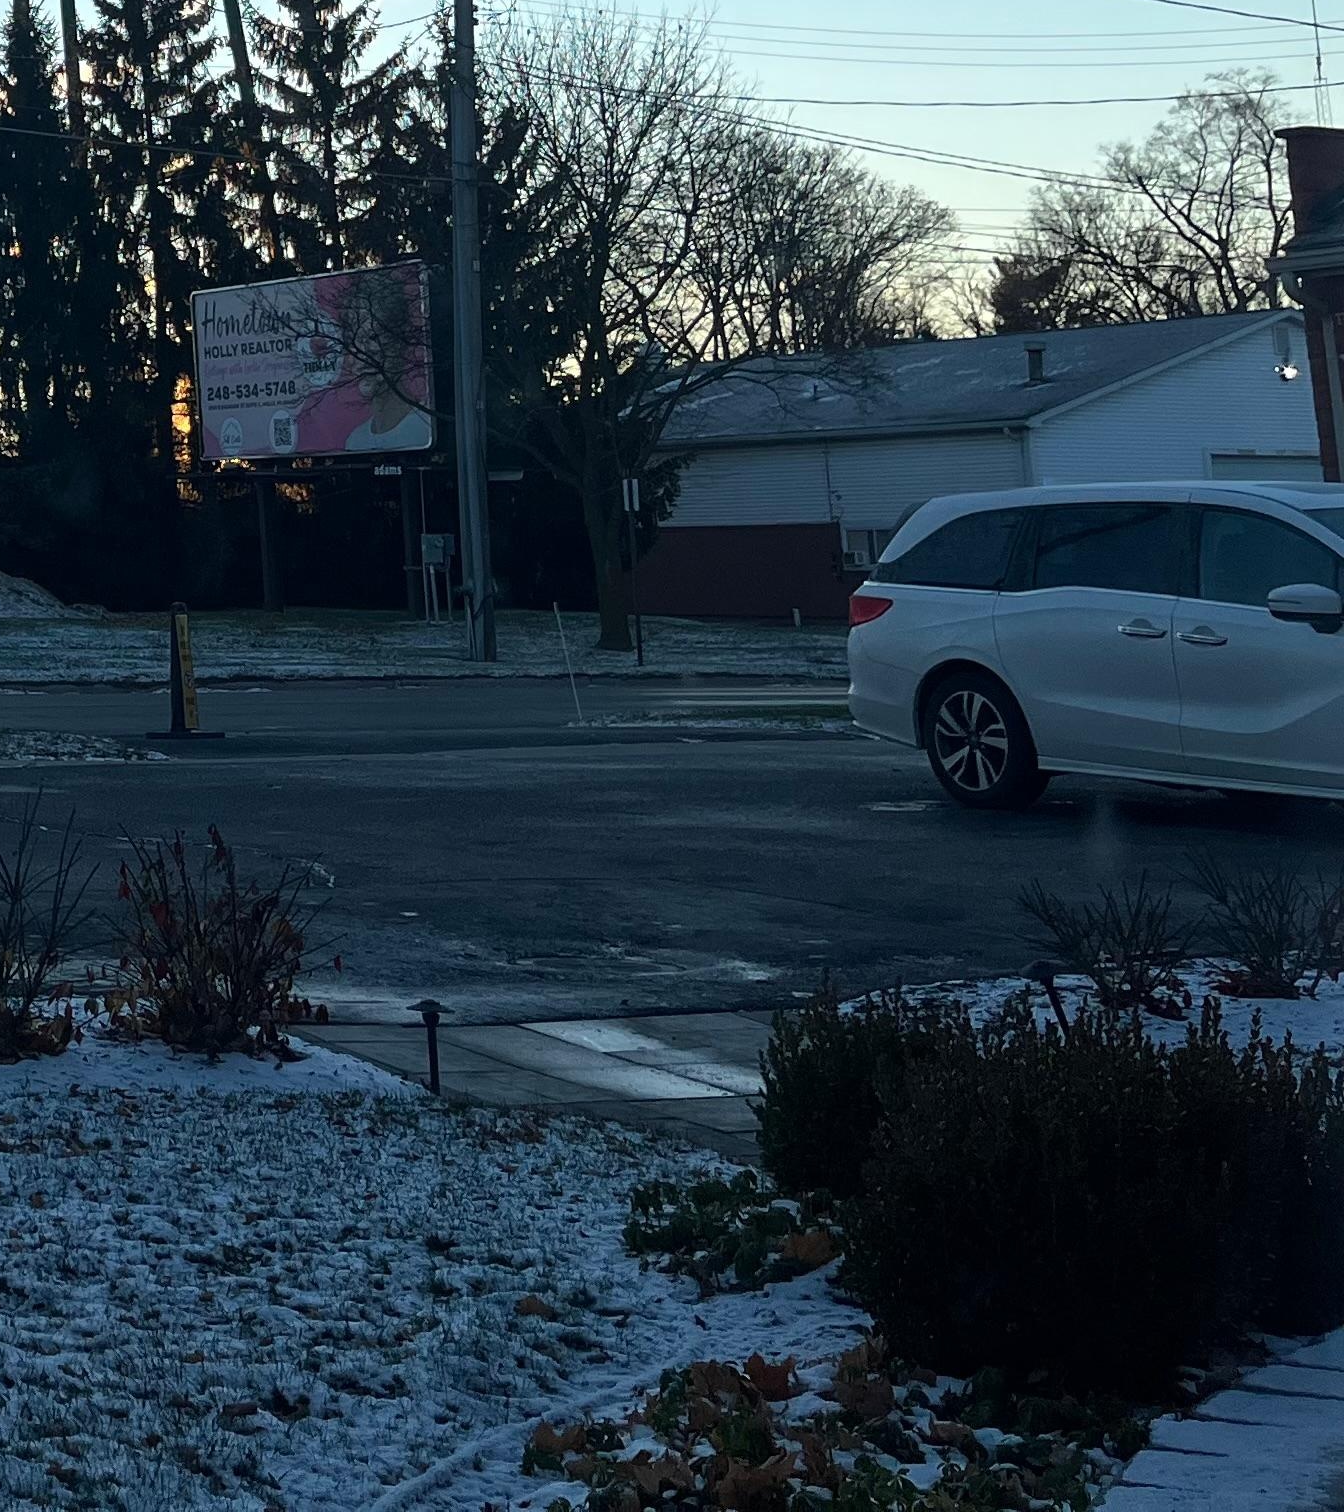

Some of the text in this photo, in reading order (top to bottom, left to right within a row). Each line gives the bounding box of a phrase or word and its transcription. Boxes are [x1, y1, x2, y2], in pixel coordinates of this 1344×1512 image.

[204, 338, 293, 360] HOLLY REALTOR
[207, 380, 296, 401] 248-534-5748
